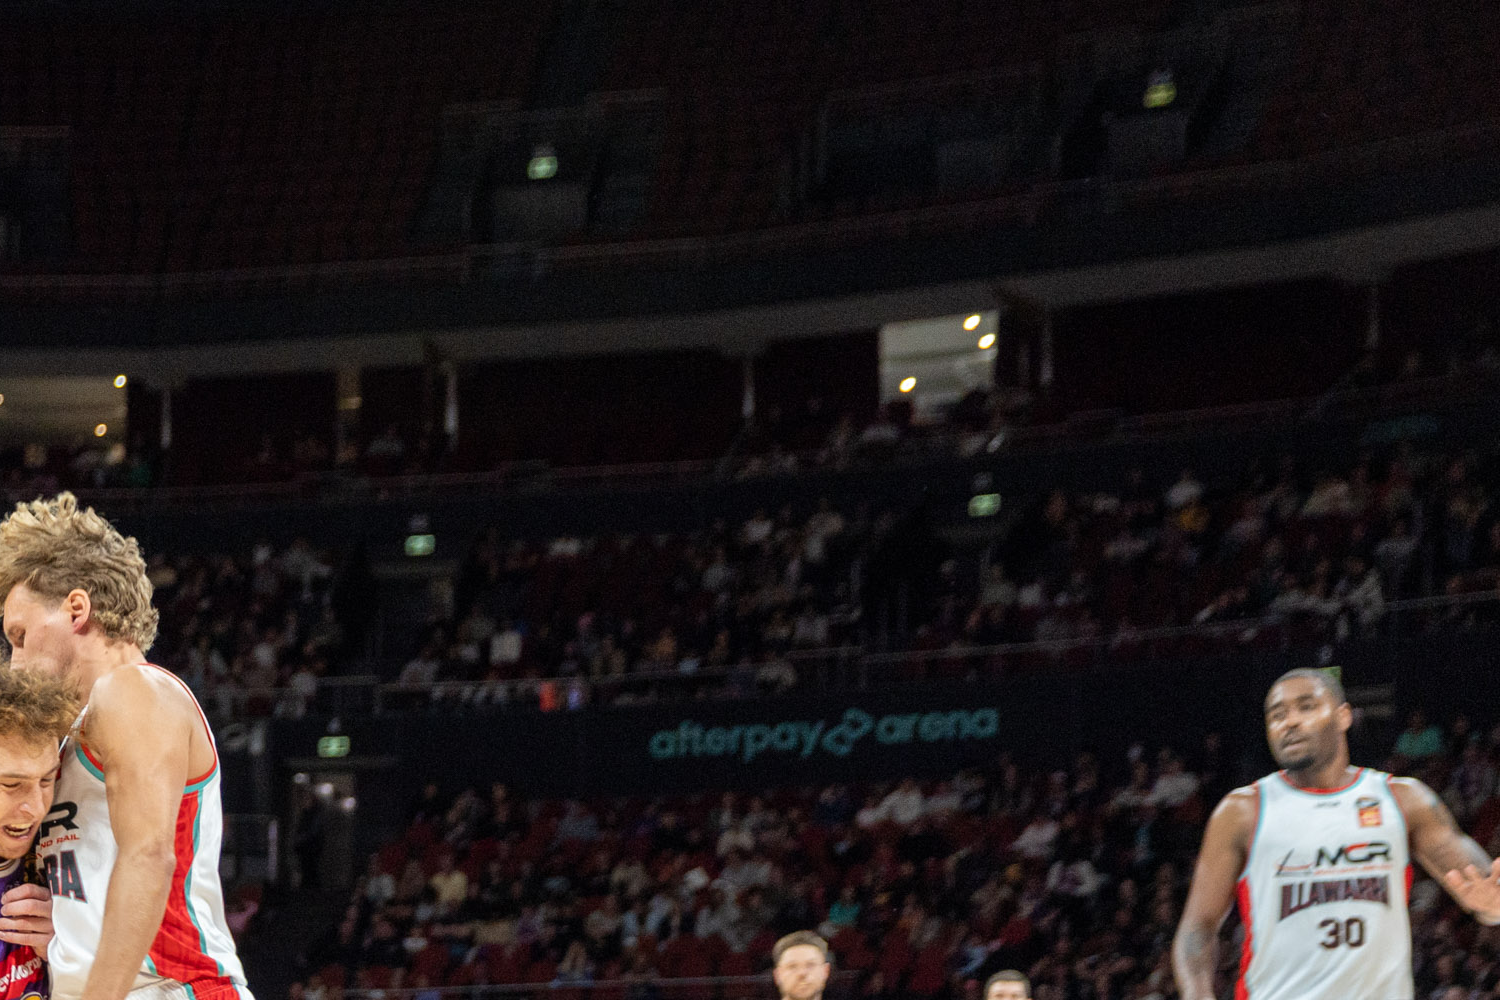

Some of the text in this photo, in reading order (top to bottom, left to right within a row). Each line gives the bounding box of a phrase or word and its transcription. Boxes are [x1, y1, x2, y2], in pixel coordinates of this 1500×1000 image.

[649, 707, 1000, 765] afterpay arena
[57, 833, 80, 845] RAIL
[1314, 841, 1392, 867] MCR
[1318, 917, 1365, 949] 30
